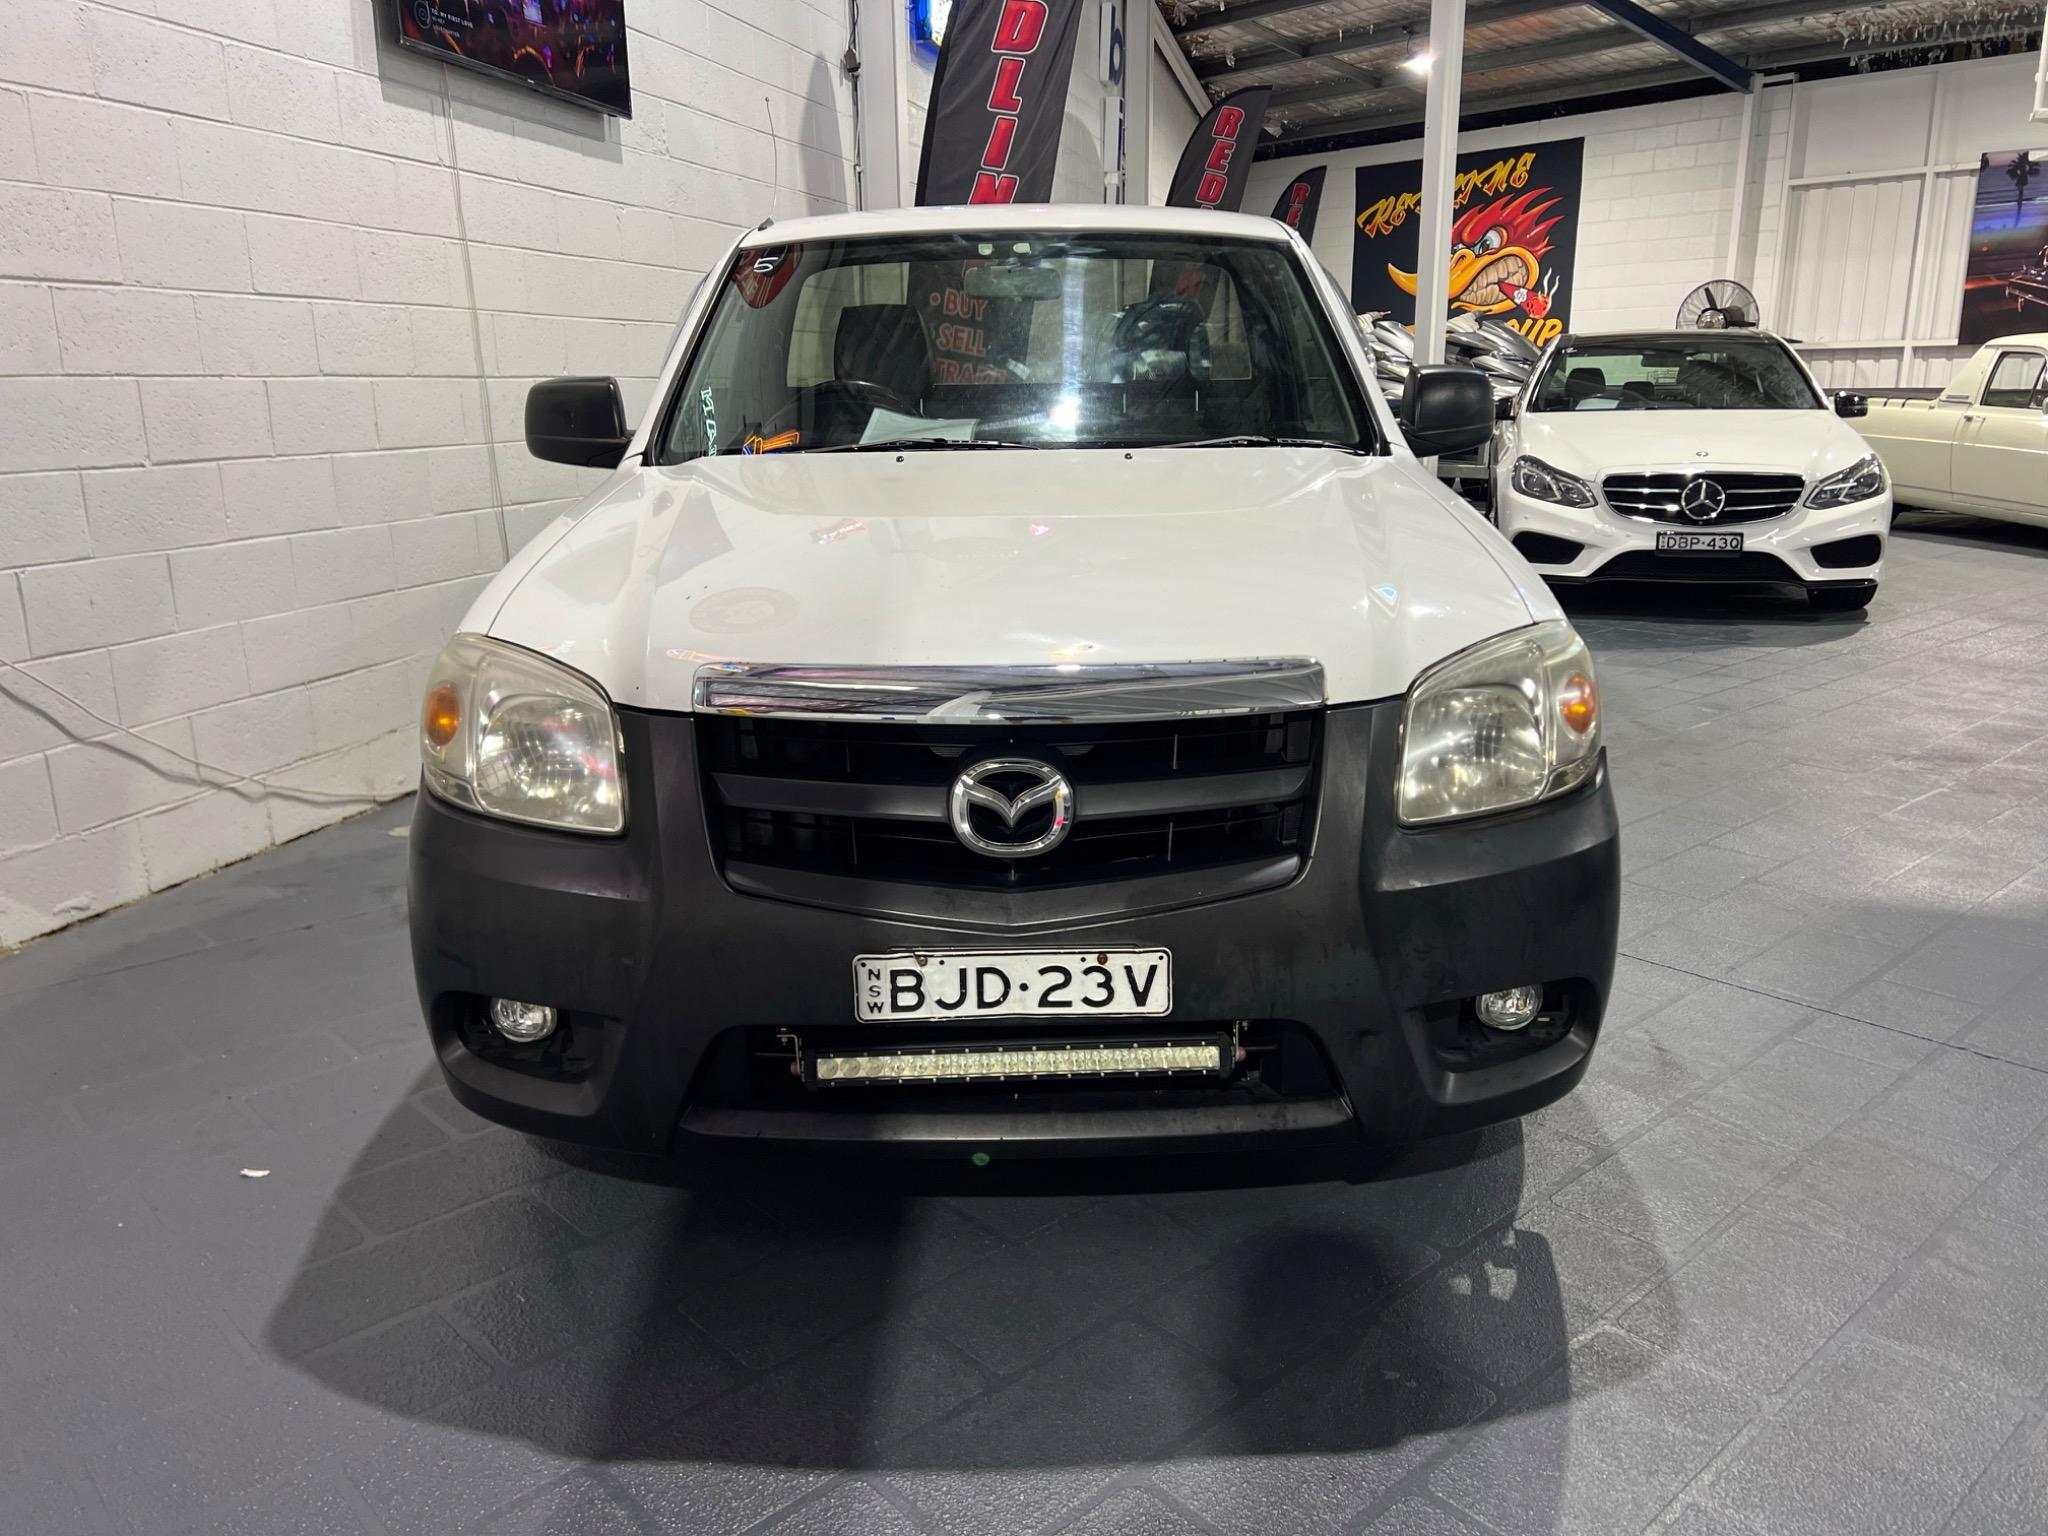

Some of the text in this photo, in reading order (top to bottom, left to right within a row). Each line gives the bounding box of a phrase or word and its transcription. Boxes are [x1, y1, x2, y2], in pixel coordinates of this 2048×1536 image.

[1195, 105, 1246, 212] RED
[943, 288, 988, 321] BUY
[935, 322, 987, 357] SELL
[867, 967, 884, 1014] NSW
